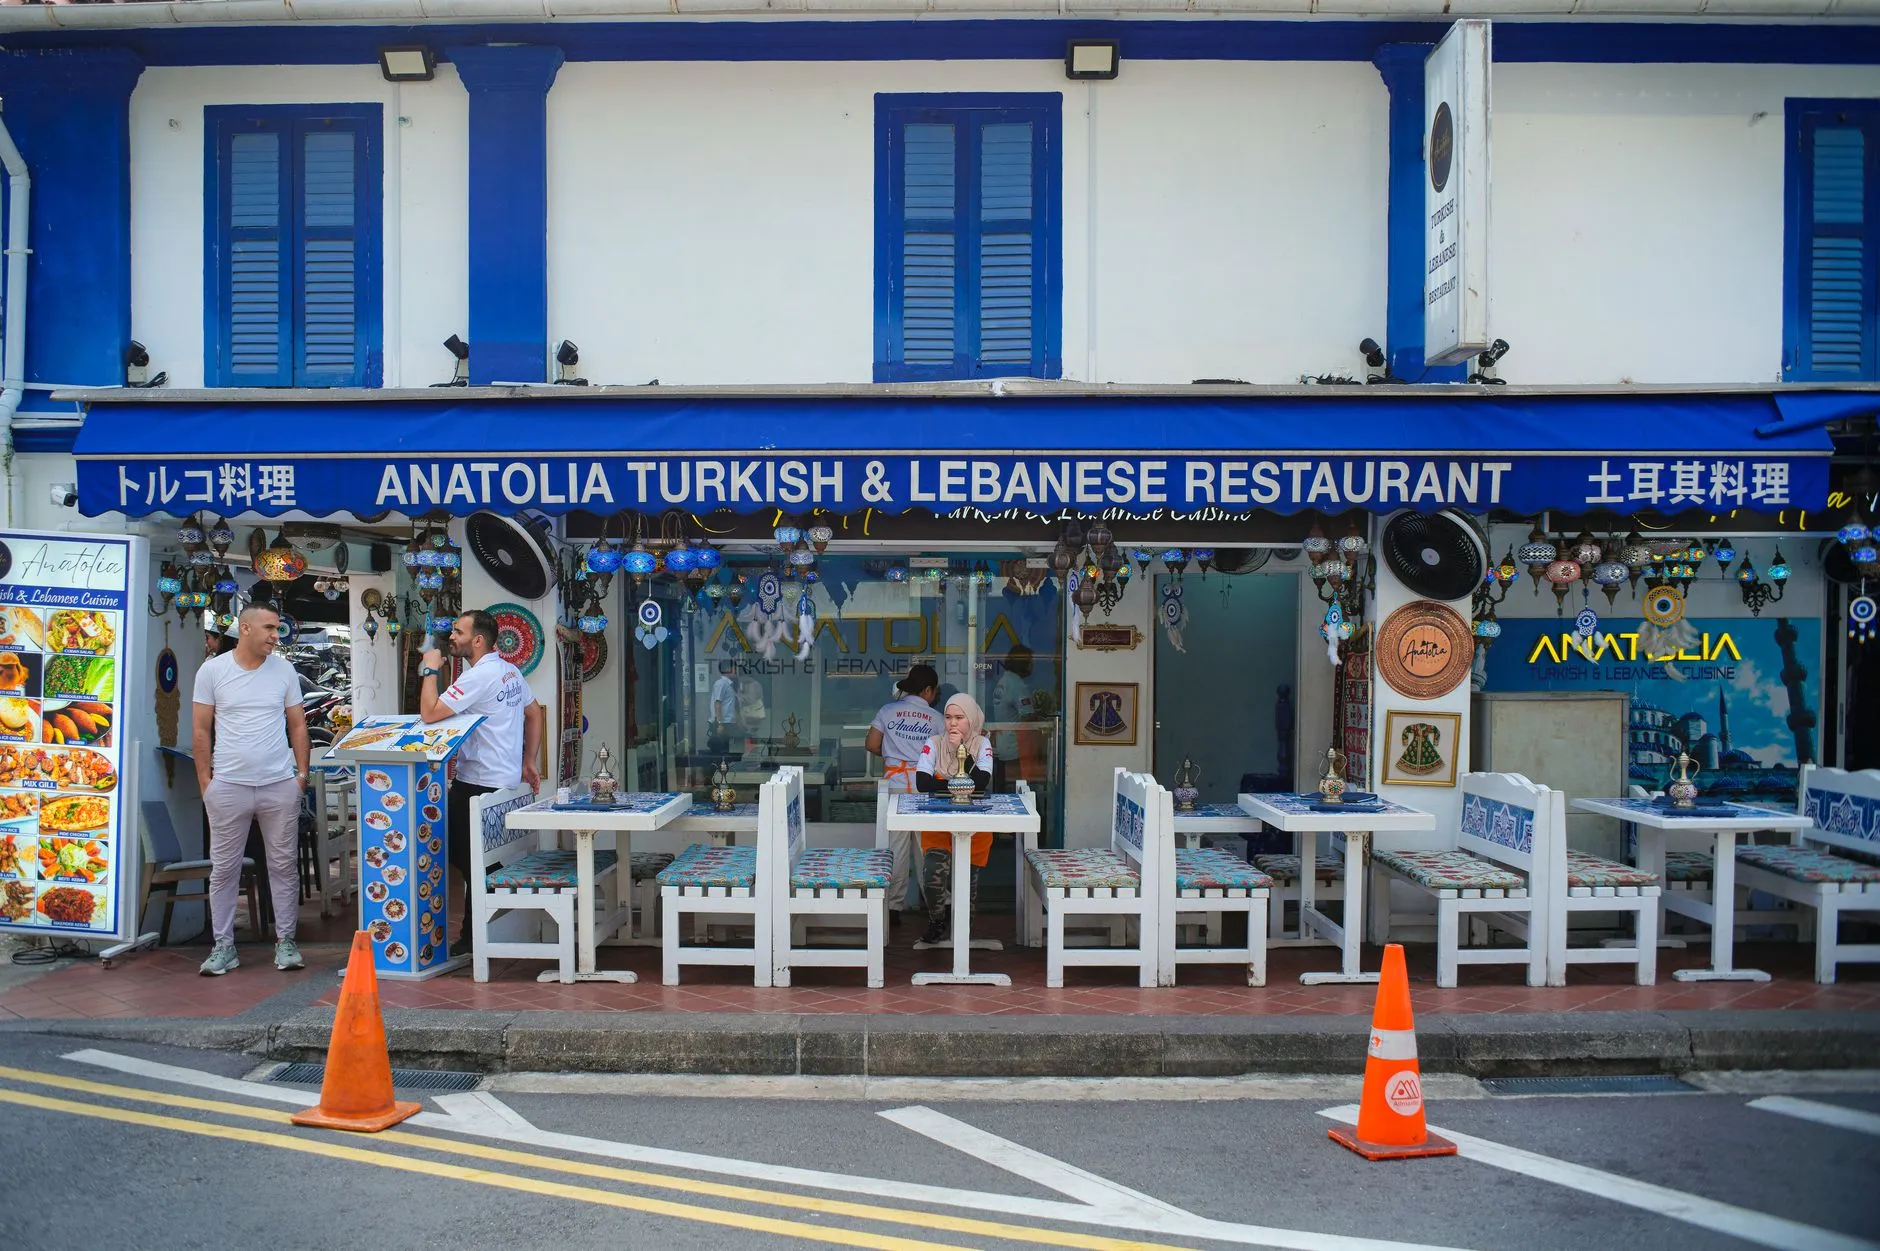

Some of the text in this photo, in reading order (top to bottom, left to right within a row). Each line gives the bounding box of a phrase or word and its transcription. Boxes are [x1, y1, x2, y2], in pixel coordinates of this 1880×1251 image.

[1431, 198, 1455, 230] TURKISH
[1439, 229, 1446, 245] &
[1428, 241, 1457, 275] LEBANESE
[1428, 275, 1457, 306] RESTAURANT
[118, 462, 297, 507] トルコ料理
[375, 460, 1512, 505] ANATOLIA TURKISH & LEBANESE RESTAURANT
[1585, 460, 1791, 505] 土耳其料理
[21, 542, 124, 590] Anatolia
[30, 587, 79, 605] Lebanese
[81, 591, 119, 607] Cuisine
[973, 663, 993, 671] OPEN
[1529, 666, 1588, 682] TURKISH
[1605, 666, 1674, 681] LEBANES
[887, 718, 933, 735] Anatolia
[896, 711, 933, 722] WELCOME
[23, 780, 56, 789] MIX GILL
